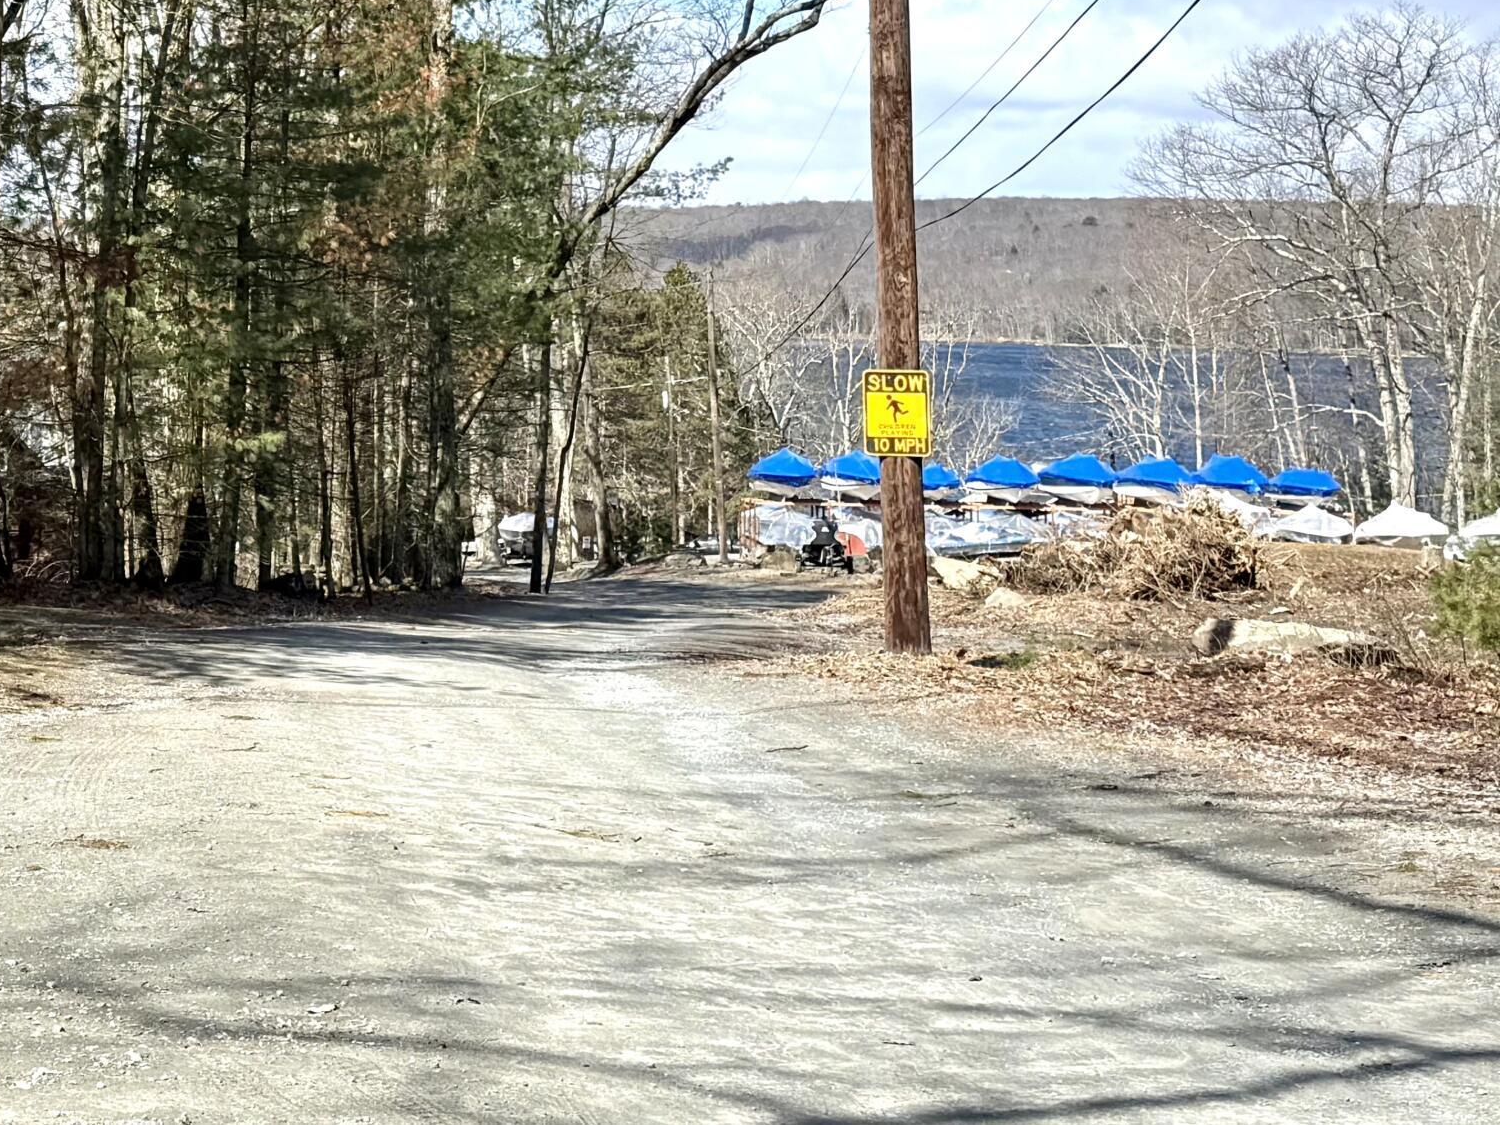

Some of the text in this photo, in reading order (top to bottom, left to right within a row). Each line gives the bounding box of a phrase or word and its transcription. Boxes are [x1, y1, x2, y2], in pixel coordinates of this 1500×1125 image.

[867, 374, 923, 392] SLOW
[873, 438, 926, 453] 10 MPH
